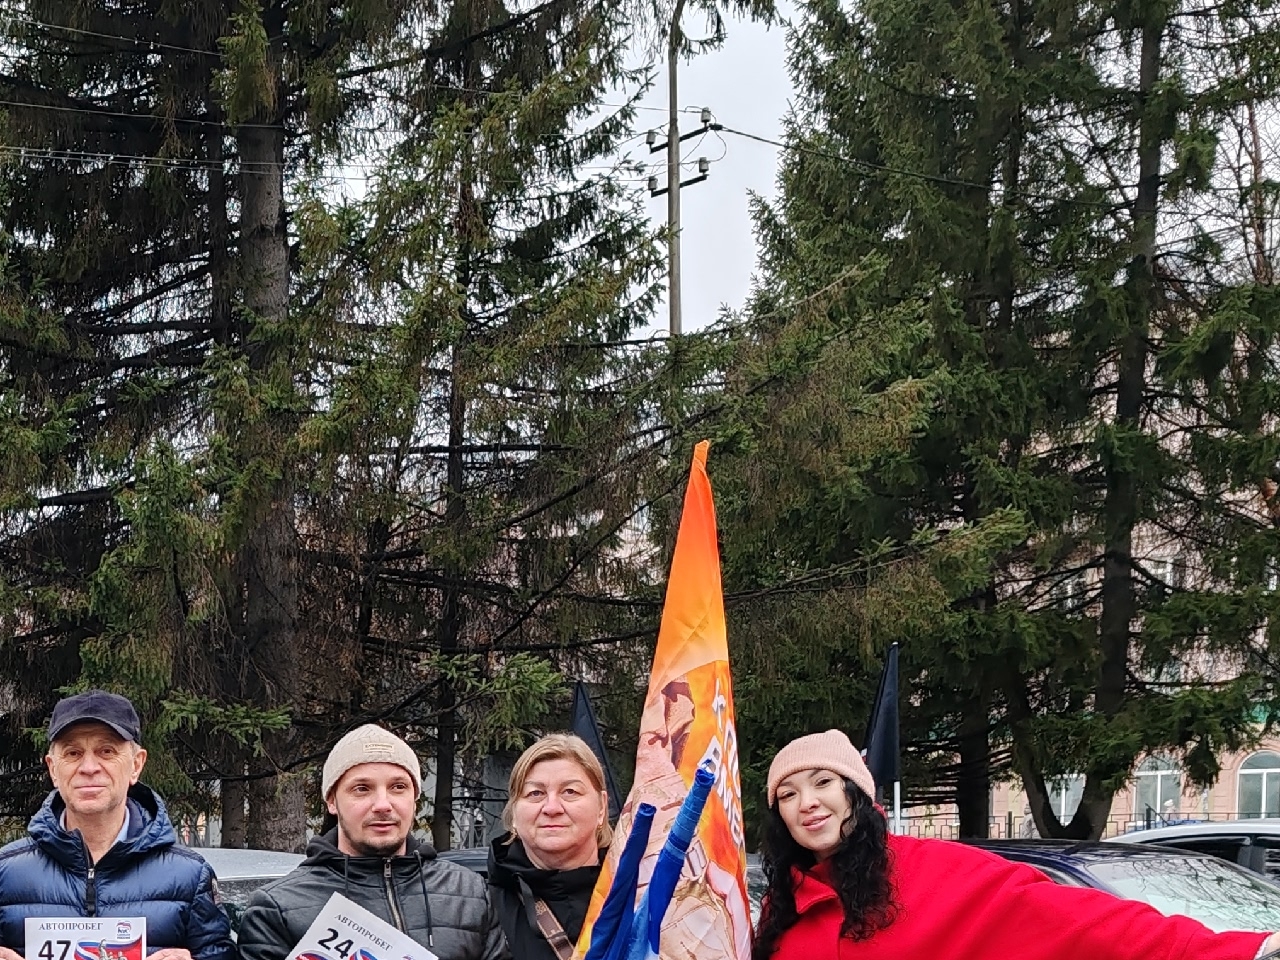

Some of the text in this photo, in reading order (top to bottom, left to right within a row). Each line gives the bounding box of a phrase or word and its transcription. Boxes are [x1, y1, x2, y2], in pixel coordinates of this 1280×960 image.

[38, 922, 104, 931] АВТОПРОБЕГ
[334, 914, 394, 952] АВТОПРОБЕГ
[317, 927, 354, 960] 24
